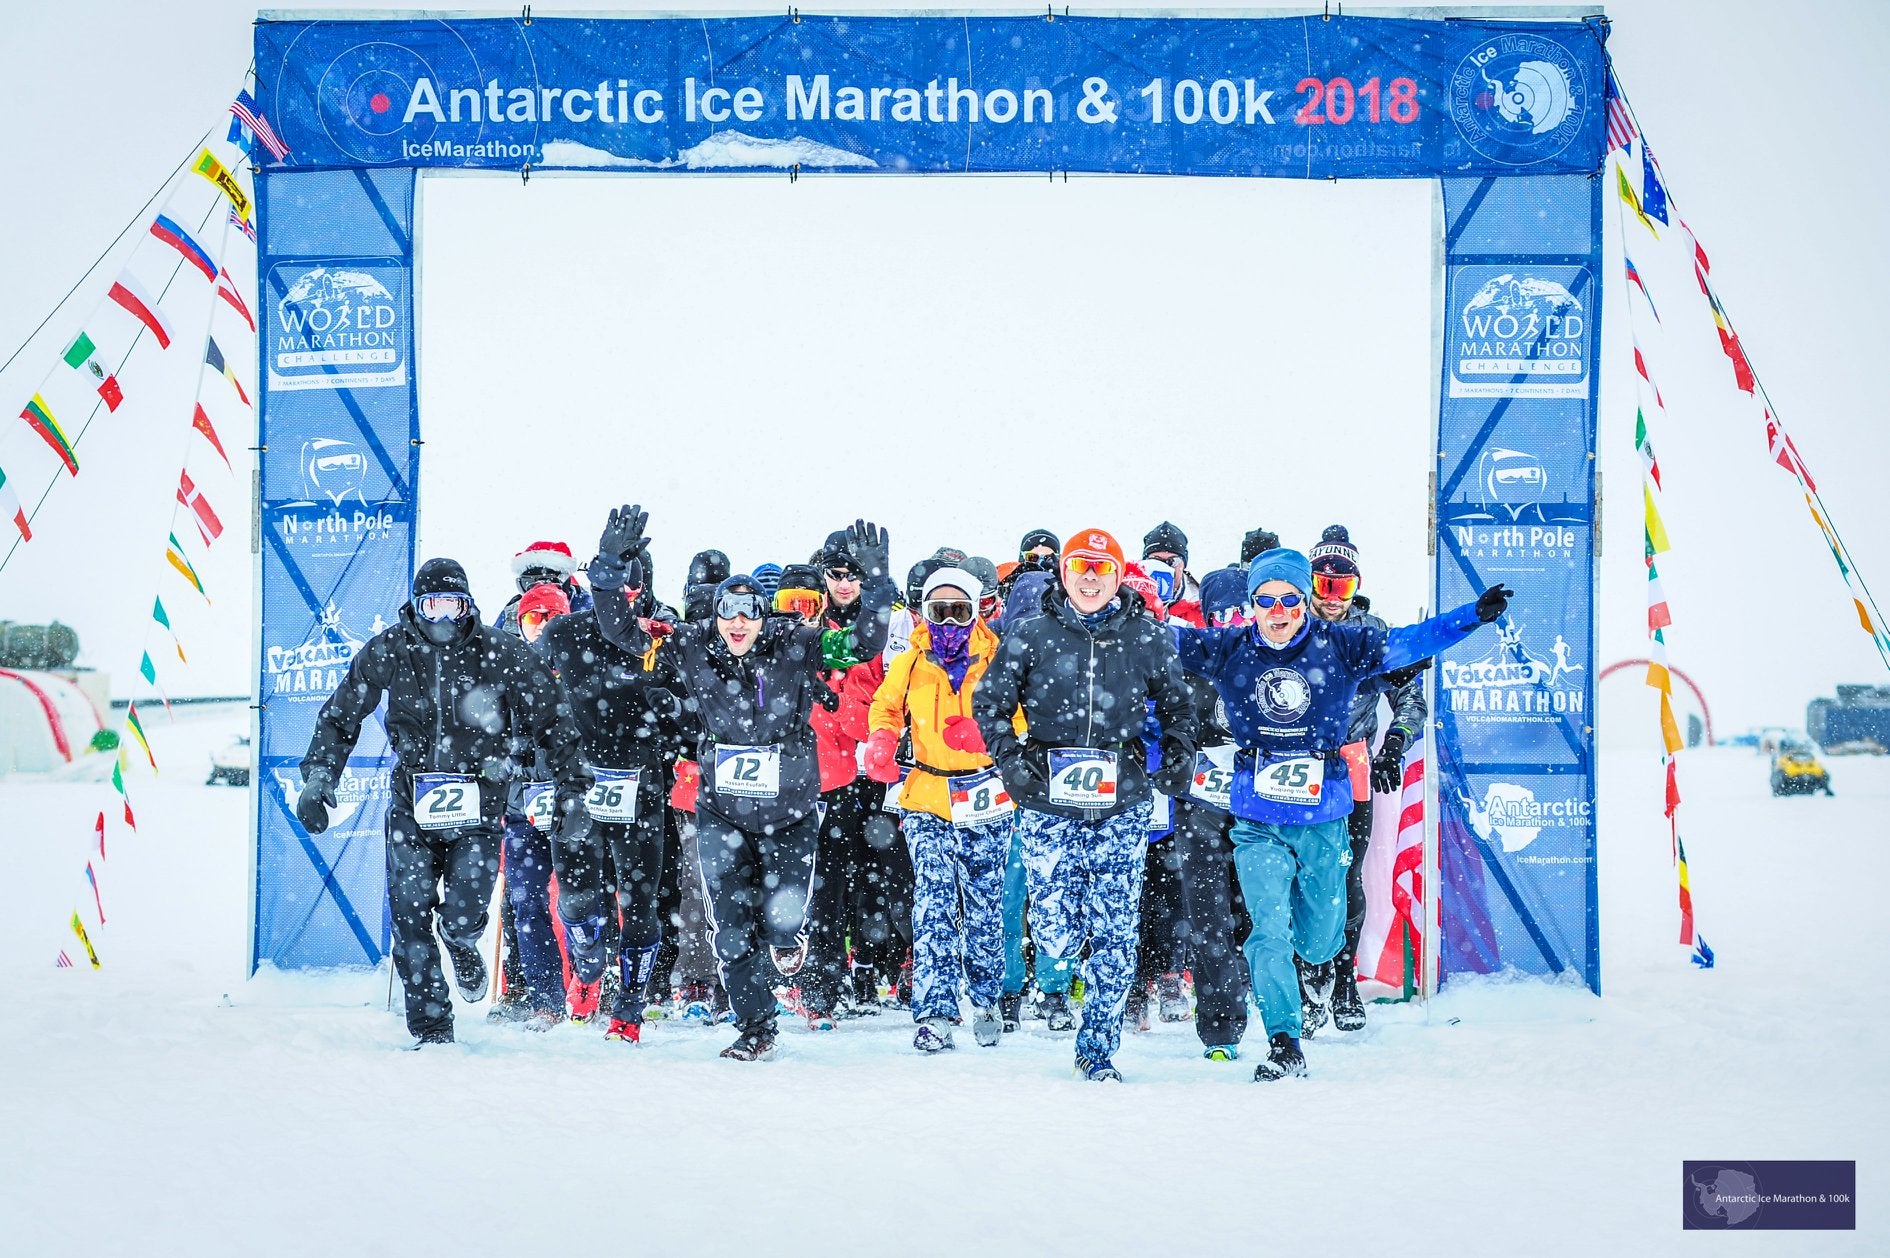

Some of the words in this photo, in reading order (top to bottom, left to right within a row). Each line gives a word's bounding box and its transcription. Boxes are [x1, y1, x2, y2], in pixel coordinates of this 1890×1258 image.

[1469, 46, 1498, 67] Ice
[1500, 36, 1577, 80] Marathon
[402, 77, 664, 124] Antarctic
[684, 77, 764, 123] Ice
[785, 74, 1053, 123] Marathon
[1077, 77, 1118, 123] &
[1141, 78, 1276, 124] 100k
[1294, 77, 1420, 124] 2018
[1455, 67, 1488, 144] Antarctic
[1552, 106, 1583, 145] 100k
[278, 331, 395, 350] MARATHON
[1460, 341, 1582, 357] MARATHON
[283, 353, 390, 364] CHALLENGE
[1465, 362, 1577, 371] CHALLENGE
[283, 512, 348, 535] North
[353, 509, 393, 531] Pole
[285, 531, 389, 545] MARATHON
[1458, 525, 1524, 547] North
[1530, 525, 1575, 547] Pole
[1460, 549, 1571, 558] MARATHON
[272, 645, 352, 671] VOLCANO
[1445, 665, 1533, 686] VOLCANO
[1451, 689, 1584, 713] MARATHON
[1466, 715, 1562, 723] VOLCANOMARATHON.COM
[733, 757, 761, 781] 12
[1063, 767, 1103, 791] 40
[1270, 763, 1310, 787] 45
[429, 788, 464, 813] 22
[589, 784, 624, 807] 36
[973, 788, 990, 811] 8
[1488, 796, 1591, 816] Antarctic
[1489, 816, 1504, 826] Ice
[1506, 816, 1555, 827] Marathon
[1558, 817, 1565, 826] &
[1568, 817, 1591, 826] 100k
[1516, 855, 1593, 865] IceMarathon.com
